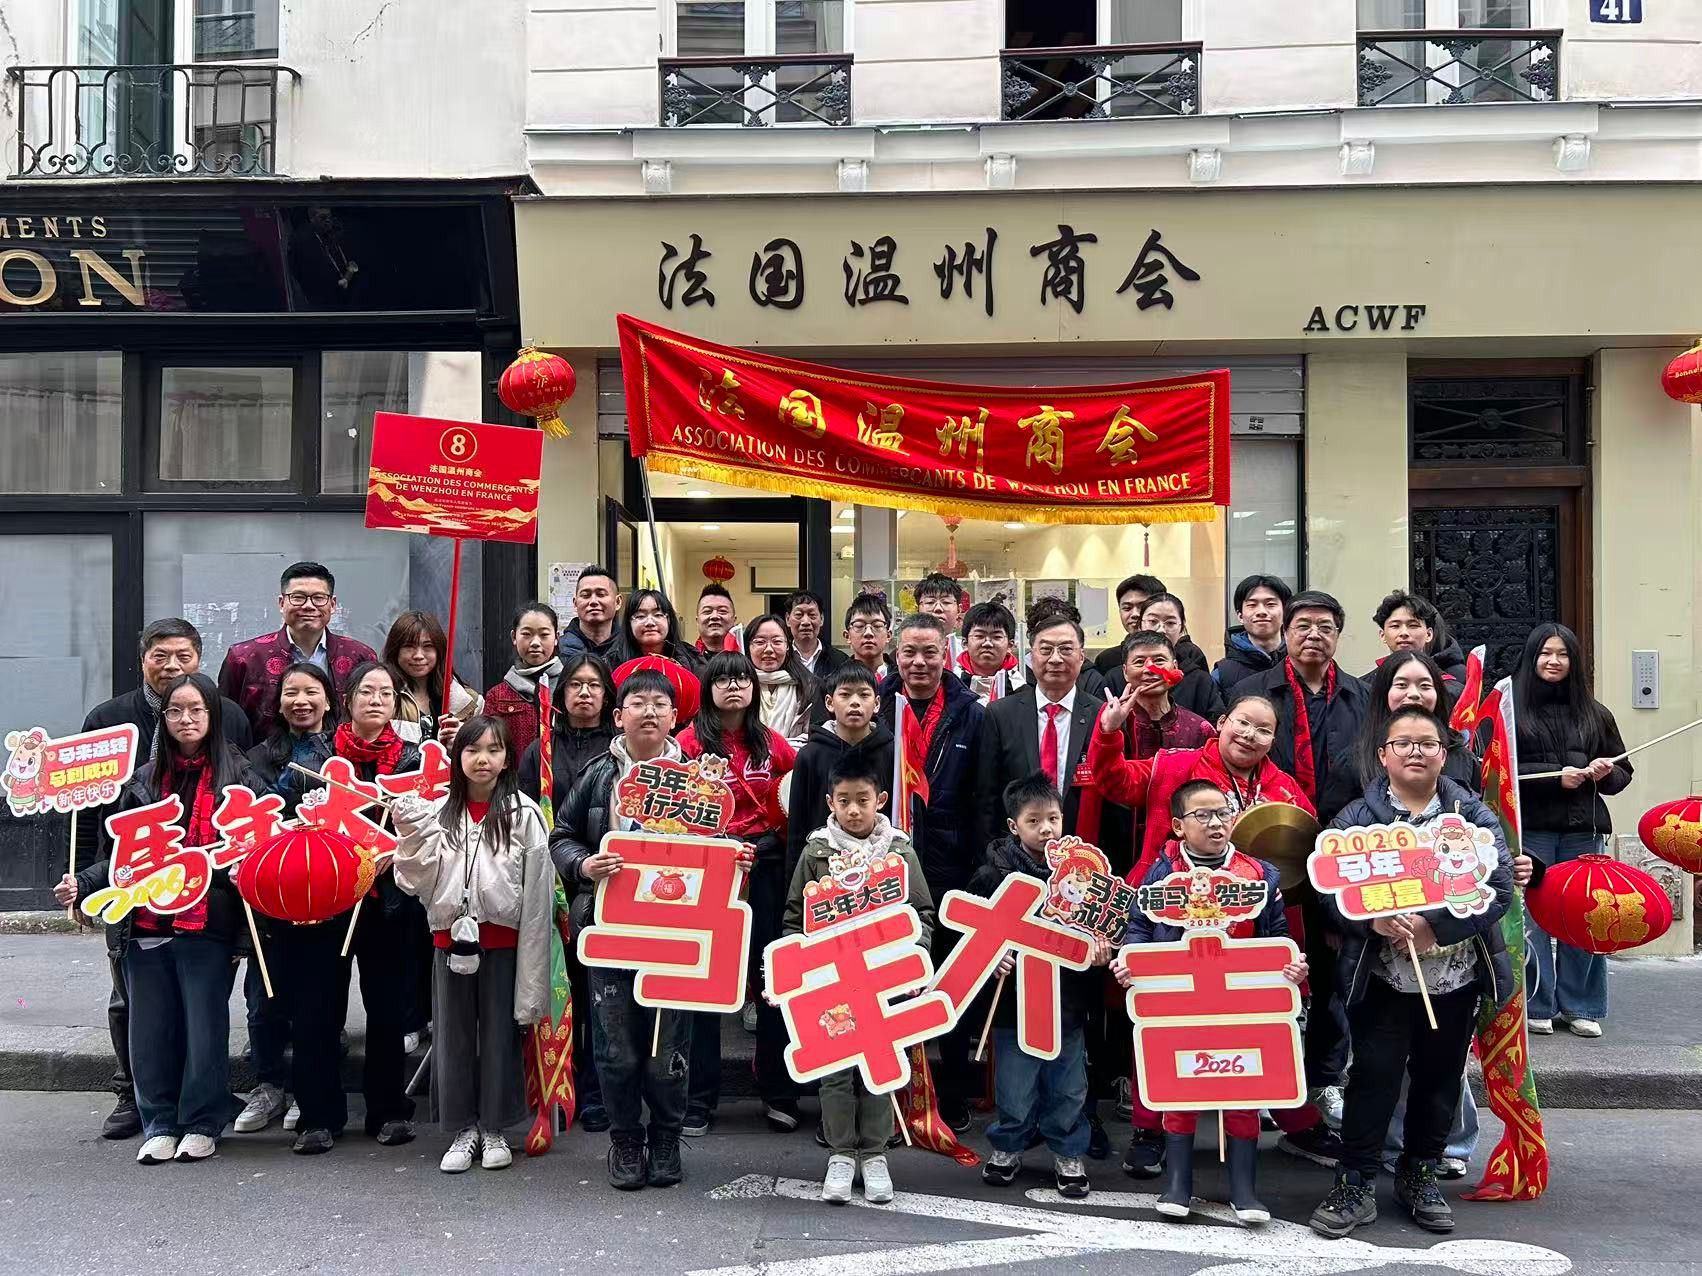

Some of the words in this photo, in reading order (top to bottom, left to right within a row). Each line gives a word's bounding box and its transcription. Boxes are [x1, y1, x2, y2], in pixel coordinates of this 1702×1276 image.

[1600, 0, 1632, 21] 41
[0, 249, 146, 306] ON
[658, 225, 1200, 316] 法国温州商会
[1303, 304, 1427, 331] ACWF
[698, 366, 1158, 475] 法国温州商会
[451, 434, 466, 456] 8
[672, 423, 787, 461] ASSOCIATION
[794, 447, 825, 468] DES
[974, 472, 997, 490] DE
[1098, 480, 1121, 495] EN
[1125, 472, 1192, 495] FRANCE
[375, 472, 441, 485] ASSOCIATION
[443, 478, 462, 487] DES
[429, 464, 483, 478] 法国温州商会
[395, 483, 409, 491] DE
[411, 484, 459, 496] WENZHOU
[461, 489, 474, 498] EN
[476, 491, 513, 501] FRANCE
[58, 736, 128, 765] 马来运转
[48, 759, 119, 788] 马到成功
[636, 764, 689, 793] 马年
[57, 781, 115, 808] 新年快乐
[644, 792, 722, 829] 行大运
[1327, 831, 1409, 855] 2026
[1336, 850, 1405, 883] 马年
[84, 867, 184, 923] 2026
[811, 876, 902, 922] 马年大吉
[1087, 872, 1135, 911] 马到
[1360, 878, 1427, 912] 暴富
[1070, 901, 1129, 943] 成功
[1193, 1052, 1245, 1076] 2026
